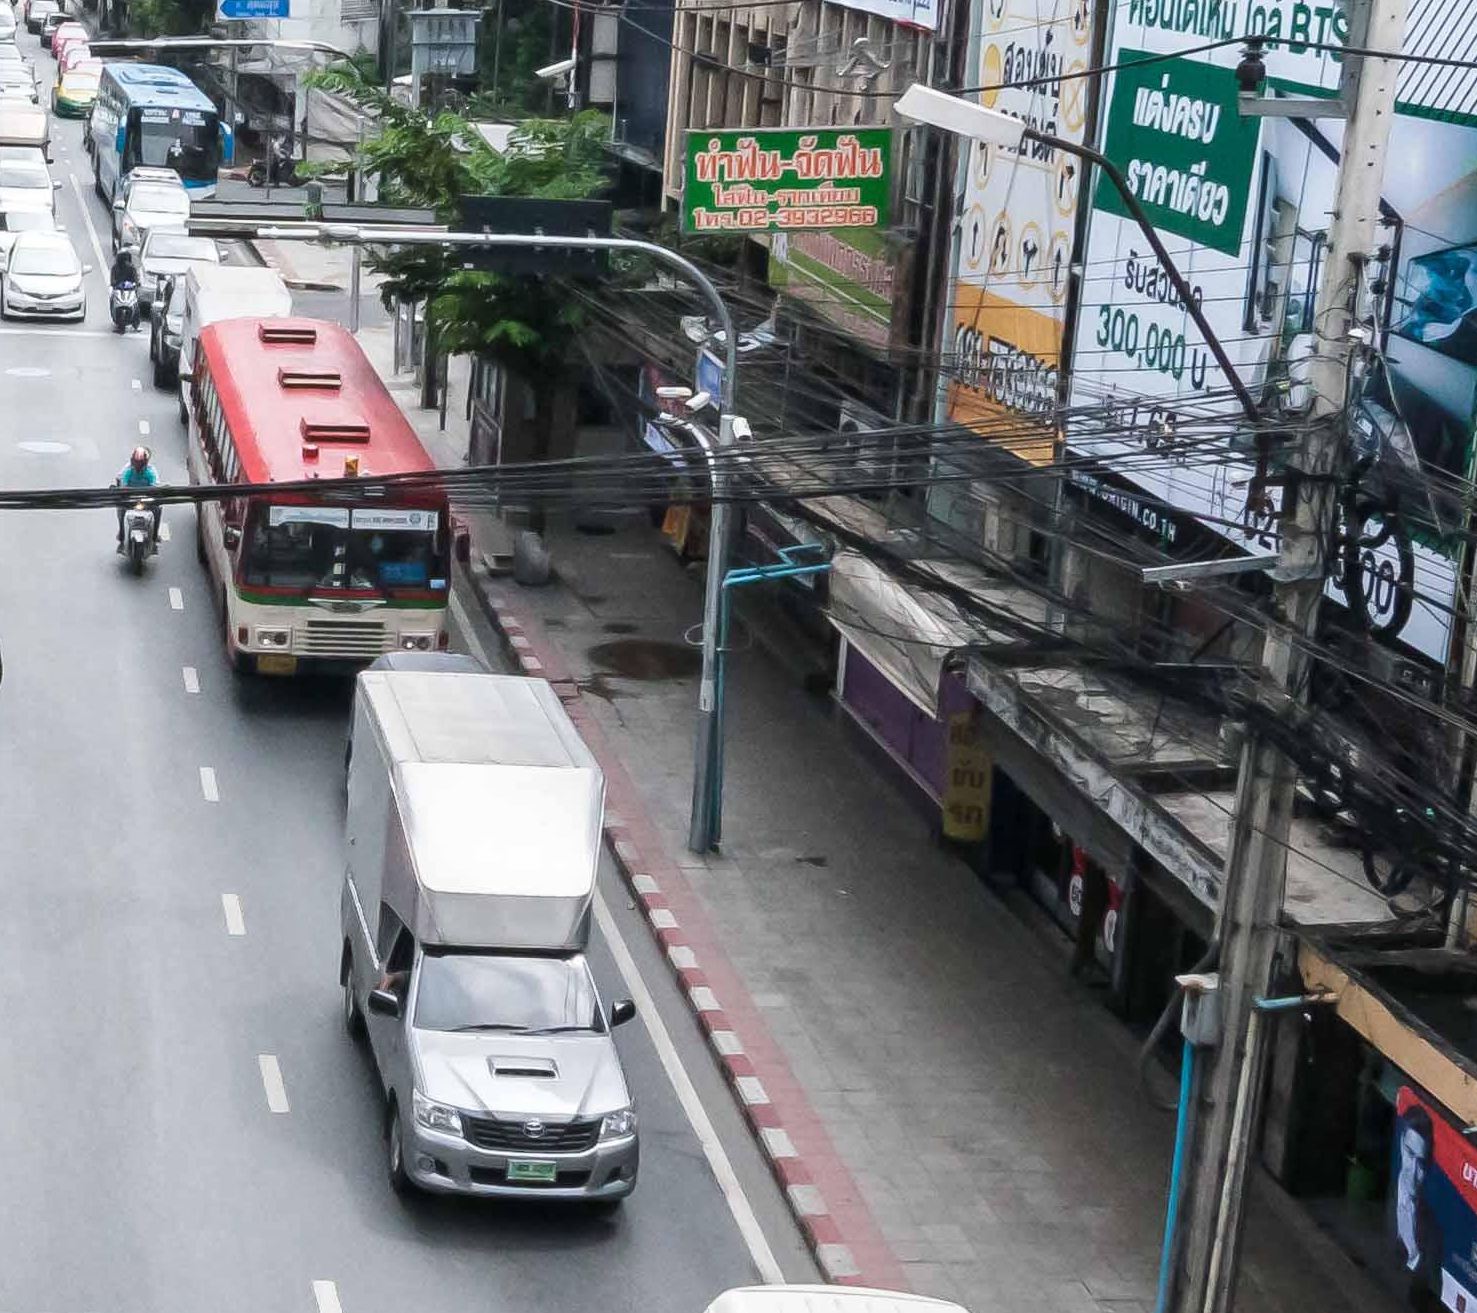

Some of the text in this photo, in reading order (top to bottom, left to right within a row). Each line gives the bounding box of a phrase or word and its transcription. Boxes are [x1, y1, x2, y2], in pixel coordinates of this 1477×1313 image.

[1132, 74, 1221, 144] แต่งครบ
[695, 135, 883, 182] ทำฟัน-จัดฟัน
[1126, 158, 1229, 226] ราคาเดียว
[1096, 303, 1186, 382] 300,000
